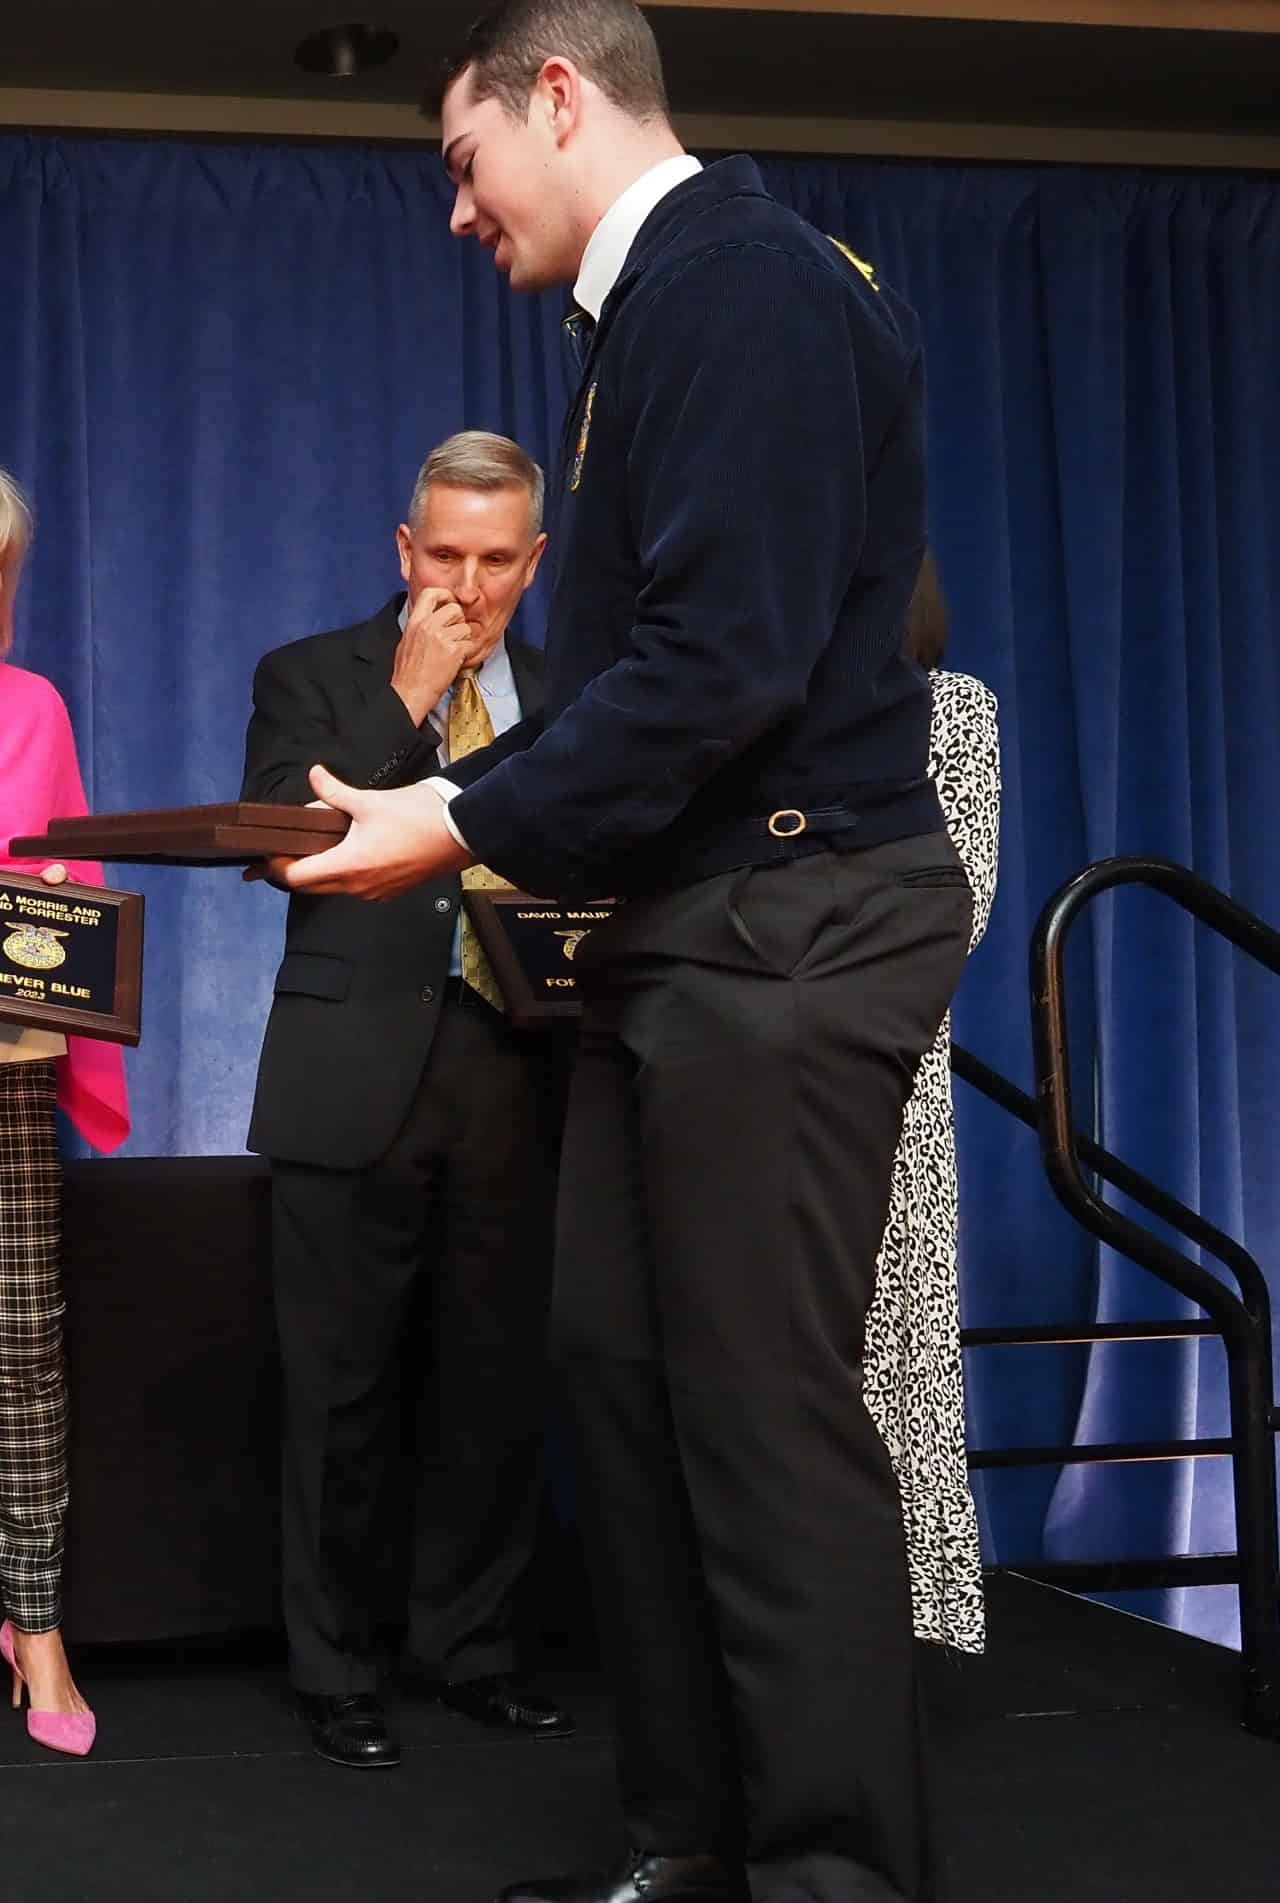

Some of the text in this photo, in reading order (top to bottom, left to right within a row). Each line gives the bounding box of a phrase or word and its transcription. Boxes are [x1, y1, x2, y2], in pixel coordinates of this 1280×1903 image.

[15, 896, 69, 912] MORRIS
[74, 905, 102, 919] AND
[19, 905, 99, 926] FORRESTER
[517, 911, 561, 919] DAVID
[51, 982, 91, 998] BLUE
